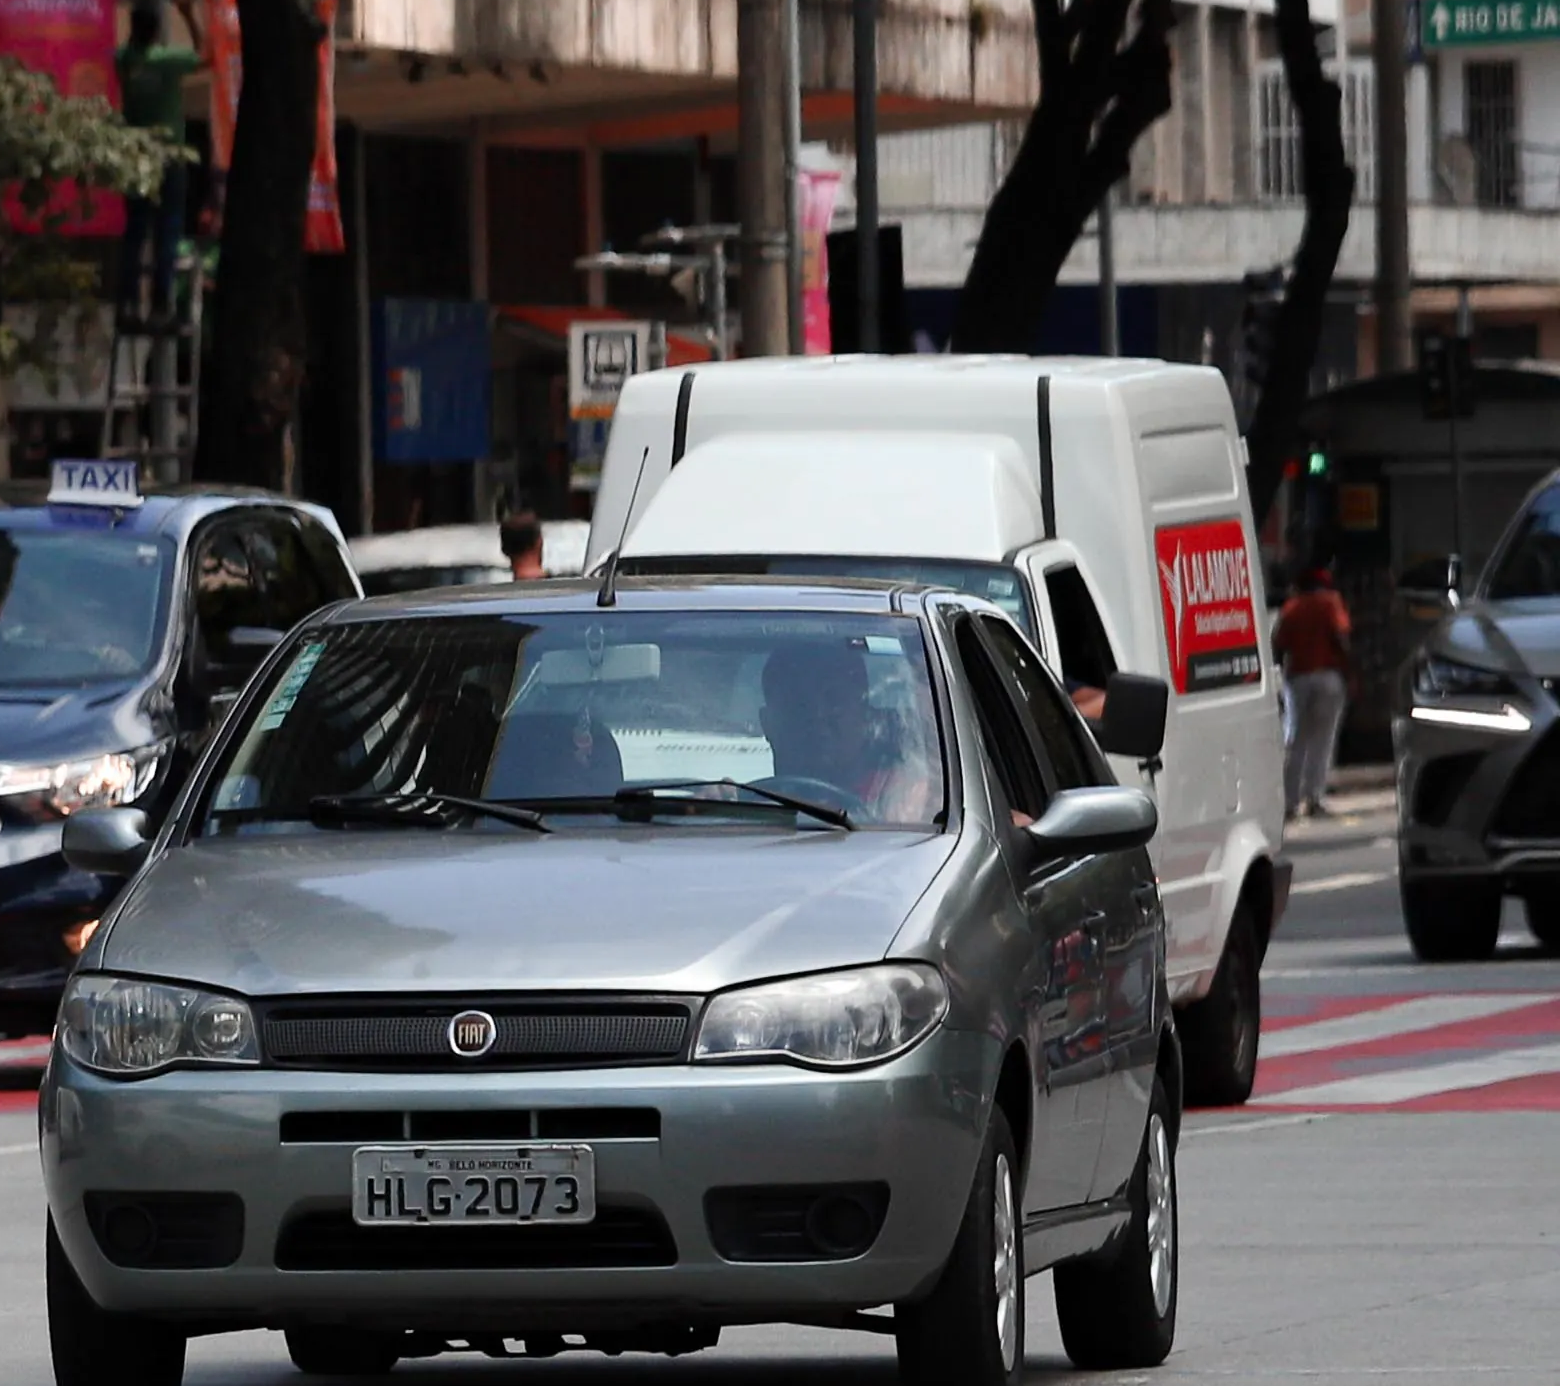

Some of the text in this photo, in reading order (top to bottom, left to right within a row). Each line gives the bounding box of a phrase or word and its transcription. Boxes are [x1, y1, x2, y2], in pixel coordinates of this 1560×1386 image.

[1455, 3, 1490, 34] RIO
[1531, 1, 1560, 29] JA
[61, 464, 130, 492] TAXI
[1182, 547, 1249, 606] LALAMOVE
[457, 1023, 486, 1045] FIAT
[478, 1159, 534, 1171] HORIZONTE
